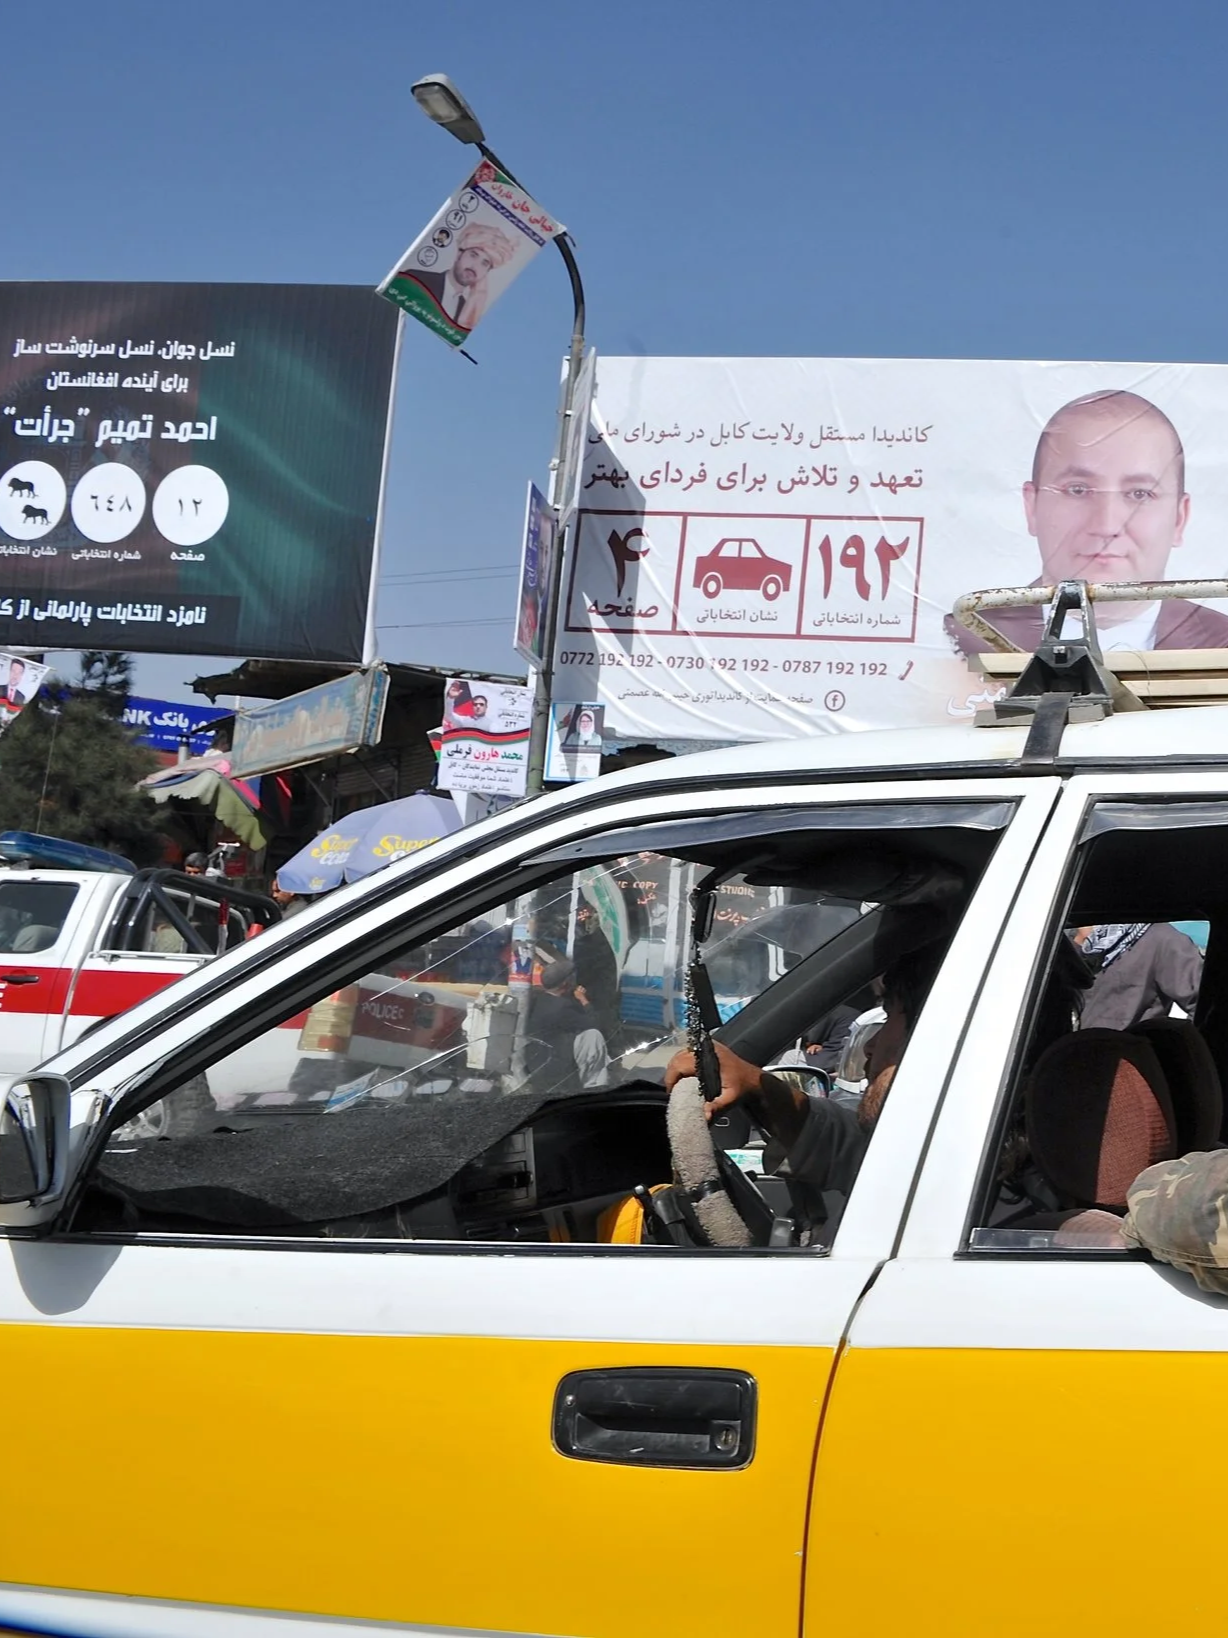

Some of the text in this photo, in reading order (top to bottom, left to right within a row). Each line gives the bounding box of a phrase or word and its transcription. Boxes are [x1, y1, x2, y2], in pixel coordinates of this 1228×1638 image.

[13, 338, 42, 358] ساز
[45, 336, 115, 359] سرنوشت
[118, 339, 155, 359] نسل
[199, 340, 236, 361] نسل
[46, 371, 189, 393] برای آینده افغانستان
[95, 414, 154, 448] تمیم
[161, 416, 218, 443] احمد
[623, 421, 682, 444] شورای
[684, 426, 705, 443] در
[709, 420, 752, 447] کابل
[752, 423, 804, 446] ولایت
[809, 425, 866, 449] مستقل
[872, 425, 934, 448] کاندیدا
[583, 460, 924, 495] تعهد و تلاش برای فردای بهتر
[32, 546, 58, 558] نشان
[71, 549, 142, 562] شماره انتخاباتی
[170, 550, 205, 562] صفحه
[16, 599, 30, 620] از
[33, 600, 93, 627] پارلمانی
[97, 603, 163, 625] انتخابات
[166, 606, 207, 627] نامزد
[587, 596, 660, 619] صفحه
[696, 609, 778, 624] نشان انتخاباتی
[812, 612, 901, 628] شماره انتخاباتی
[560, 651, 595, 666] 0772
[630, 654, 654, 668] 192
[666, 656, 705, 670] 0730
[742, 658, 769, 672] 192
[782, 660, 822, 674] 0787
[826, 661, 855, 675] 192
[859, 662, 888, 676] 192
[153, 711, 189, 733] بانک
[632, 880, 659, 890] COPY
